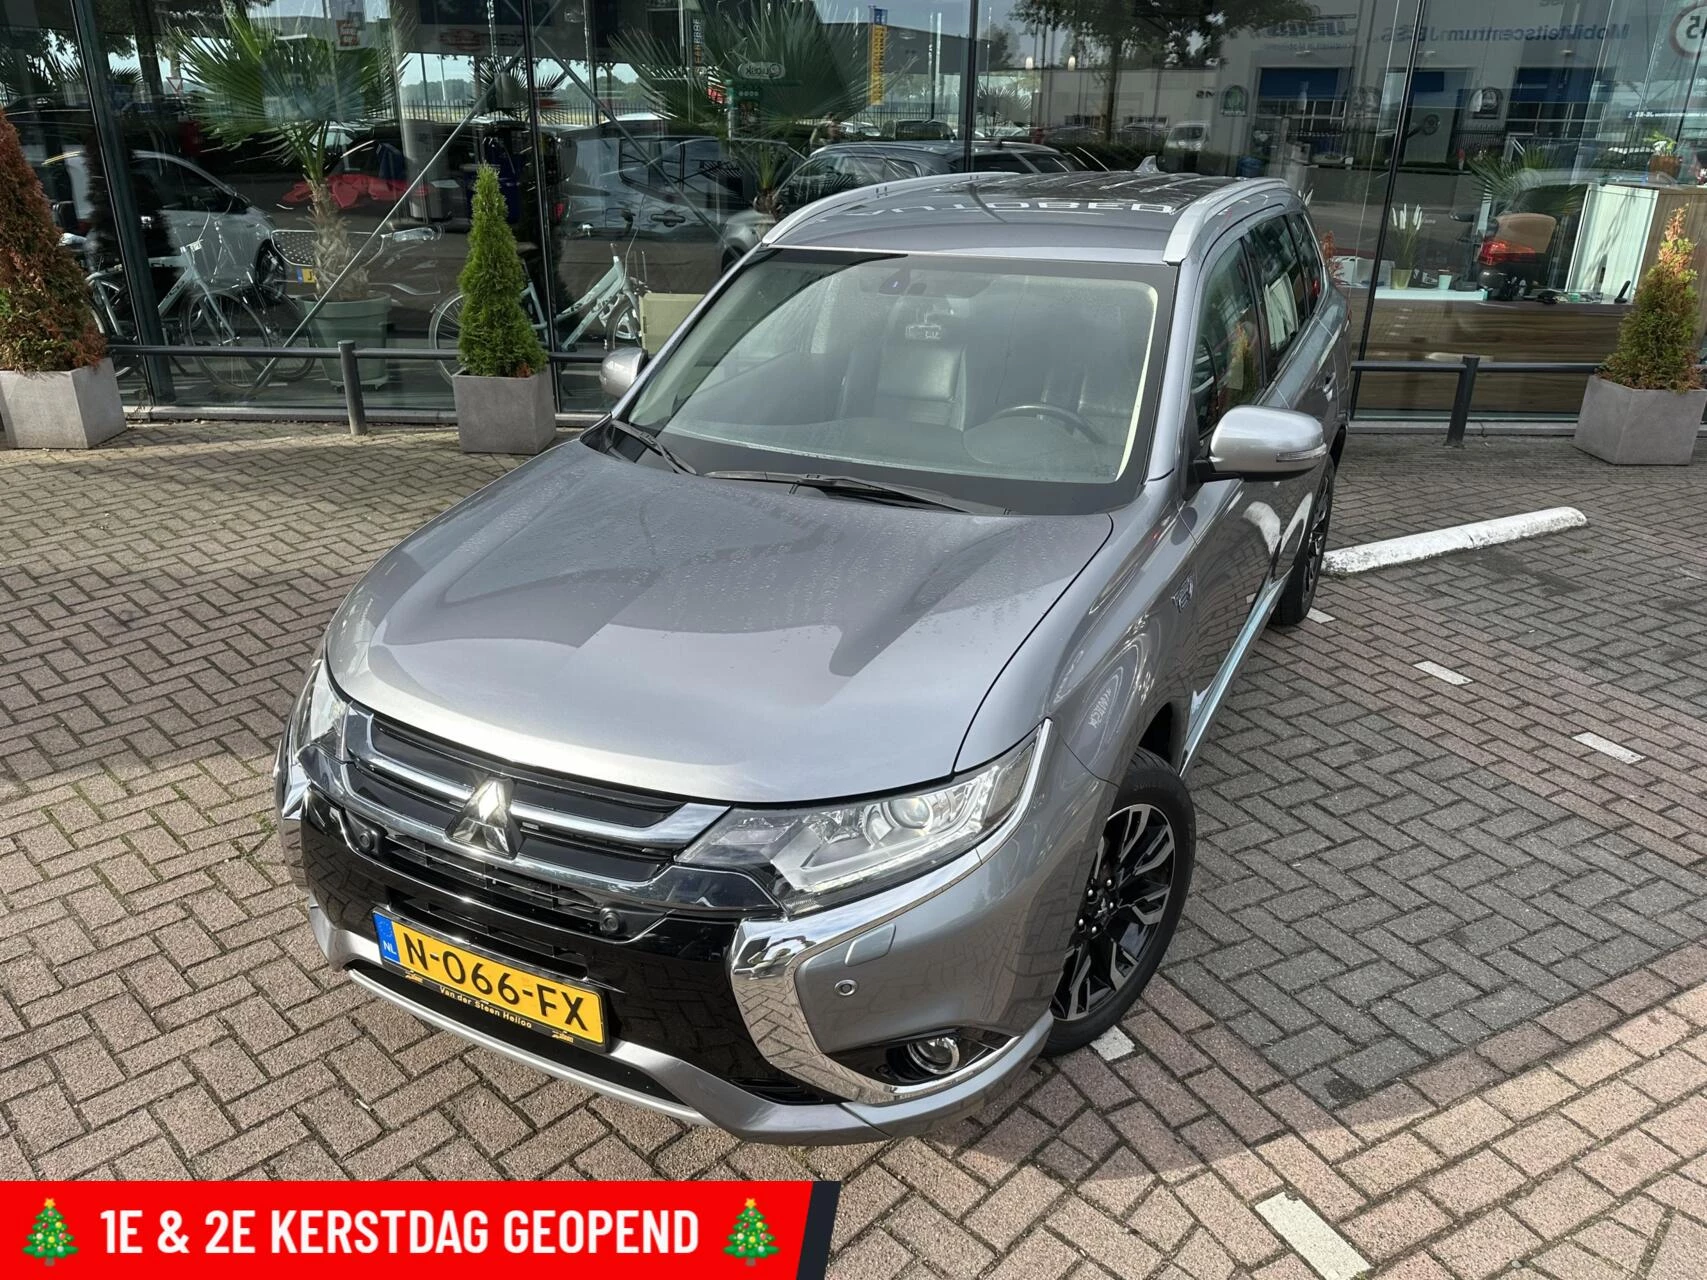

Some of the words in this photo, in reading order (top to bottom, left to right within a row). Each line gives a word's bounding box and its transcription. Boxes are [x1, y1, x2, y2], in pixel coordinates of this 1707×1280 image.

[382, 940, 397, 955] NL
[403, 932, 588, 1032] N-066-FX
[440, 985, 455, 998] Van
[457, 994, 472, 1005] der
[475, 1001, 500, 1016] Steen
